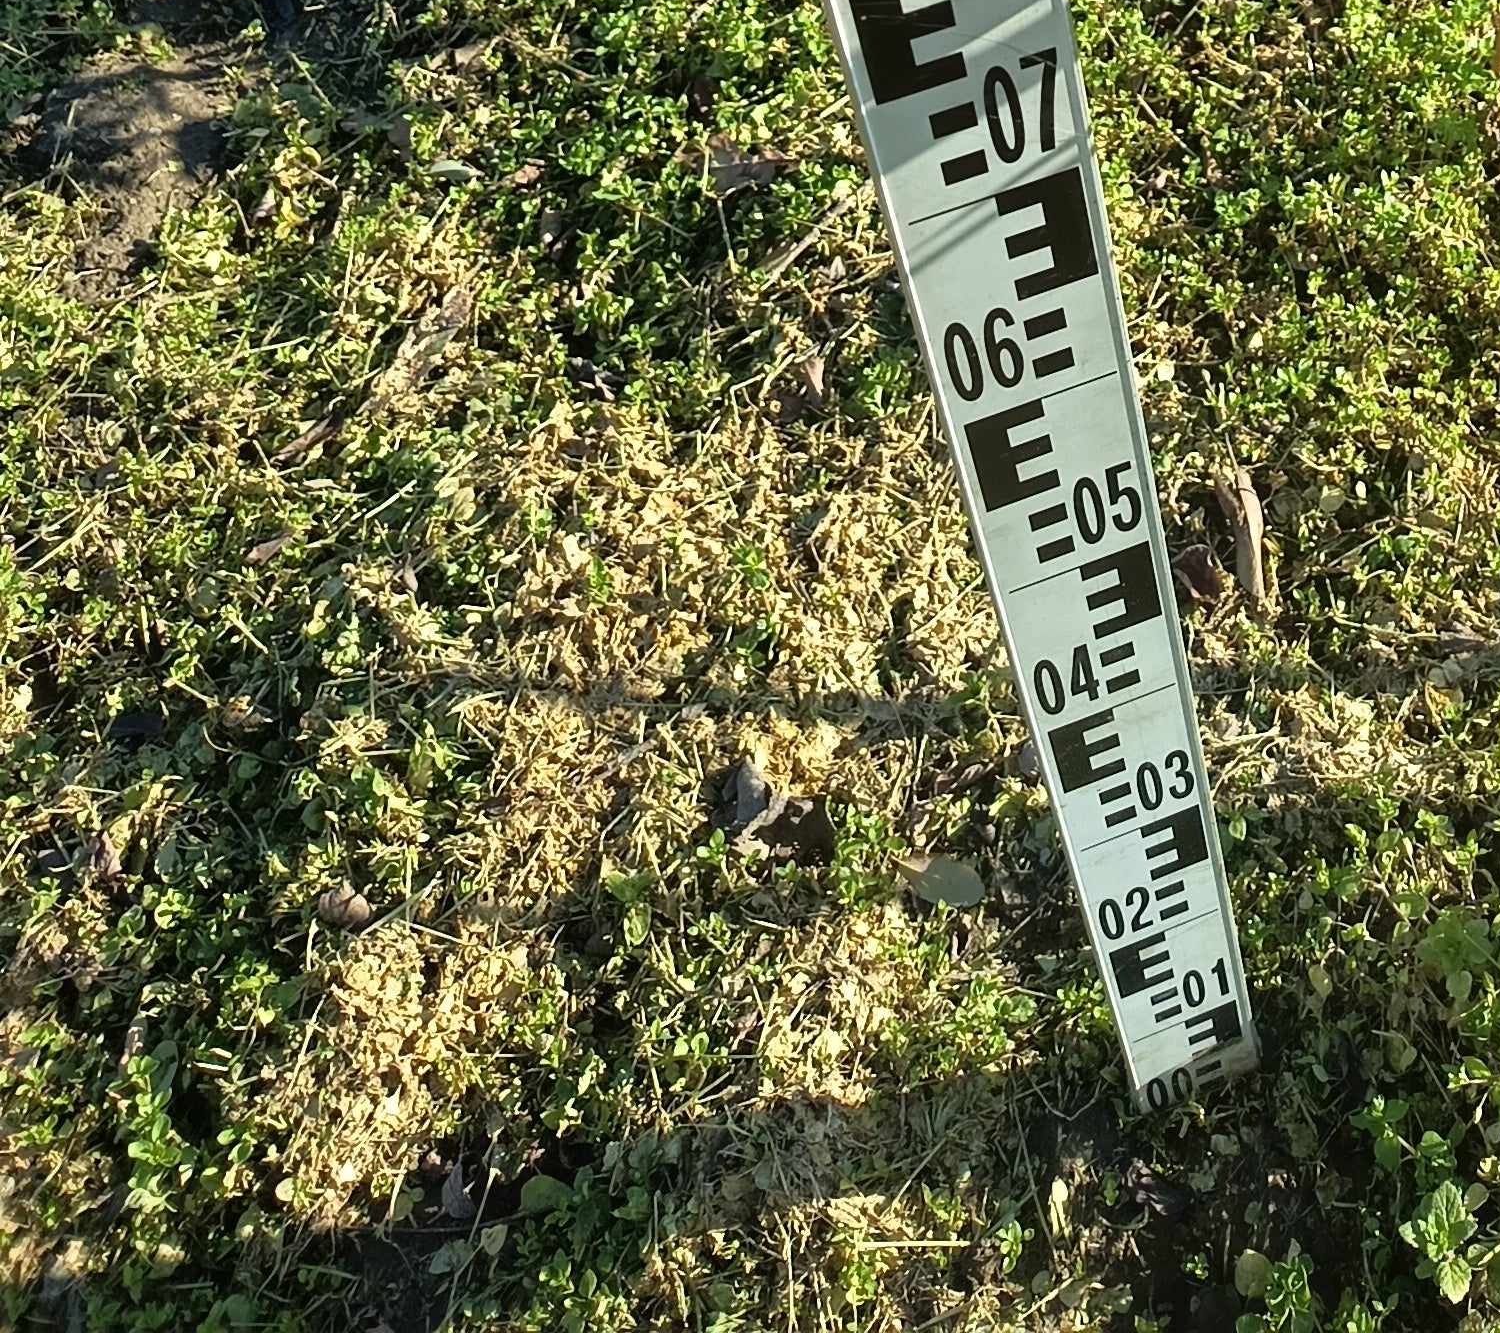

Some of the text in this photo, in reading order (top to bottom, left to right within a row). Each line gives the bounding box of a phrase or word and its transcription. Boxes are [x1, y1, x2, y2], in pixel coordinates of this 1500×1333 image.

[983, 47, 1059, 164] 07
[943, 307, 1025, 403] 06
[1072, 462, 1142, 546] 05
[1033, 644, 1100, 716] 04
[1136, 750, 1195, 813] 03
[1098, 886, 1154, 941] 02
[1182, 958, 1231, 1009] 01
[1147, 1068, 1194, 1113] 00
